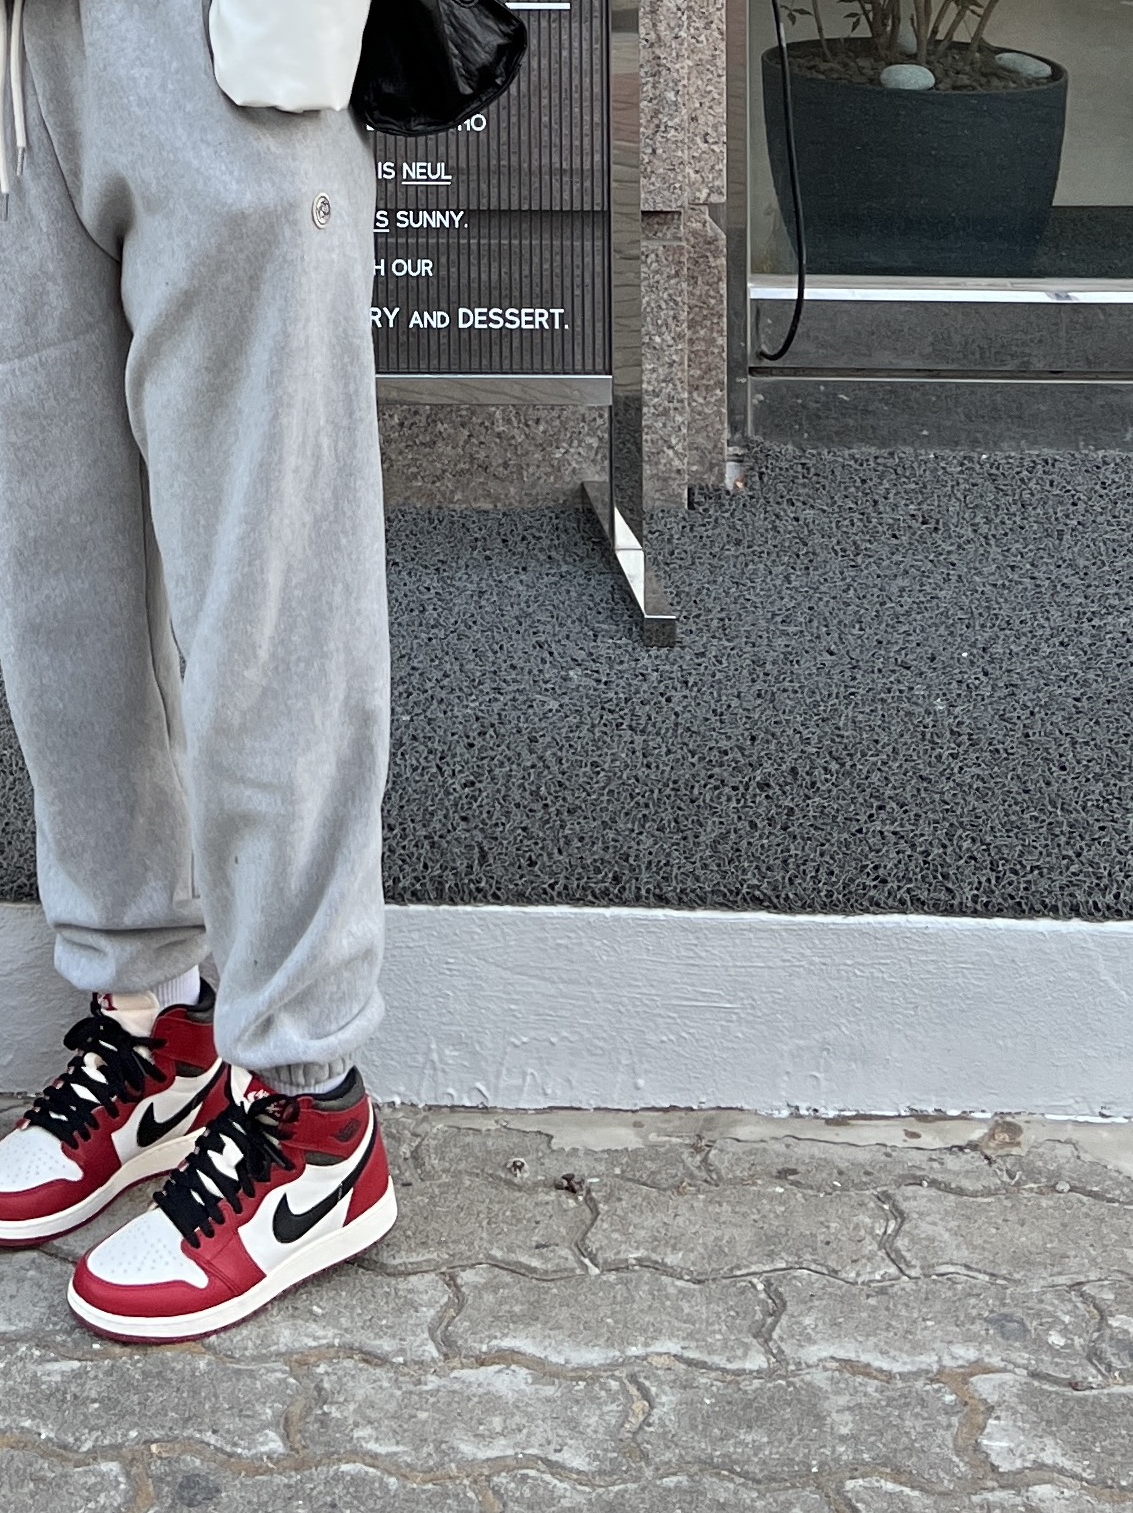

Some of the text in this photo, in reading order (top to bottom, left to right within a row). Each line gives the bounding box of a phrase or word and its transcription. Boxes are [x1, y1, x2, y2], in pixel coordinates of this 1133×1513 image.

[377, 162, 452, 180] IS NEUL
[396, 210, 469, 229] SUNNY.
[391, 259, 434, 277] OUR
[409, 311, 450, 329] AND
[458, 308, 569, 330] DESSERT.
